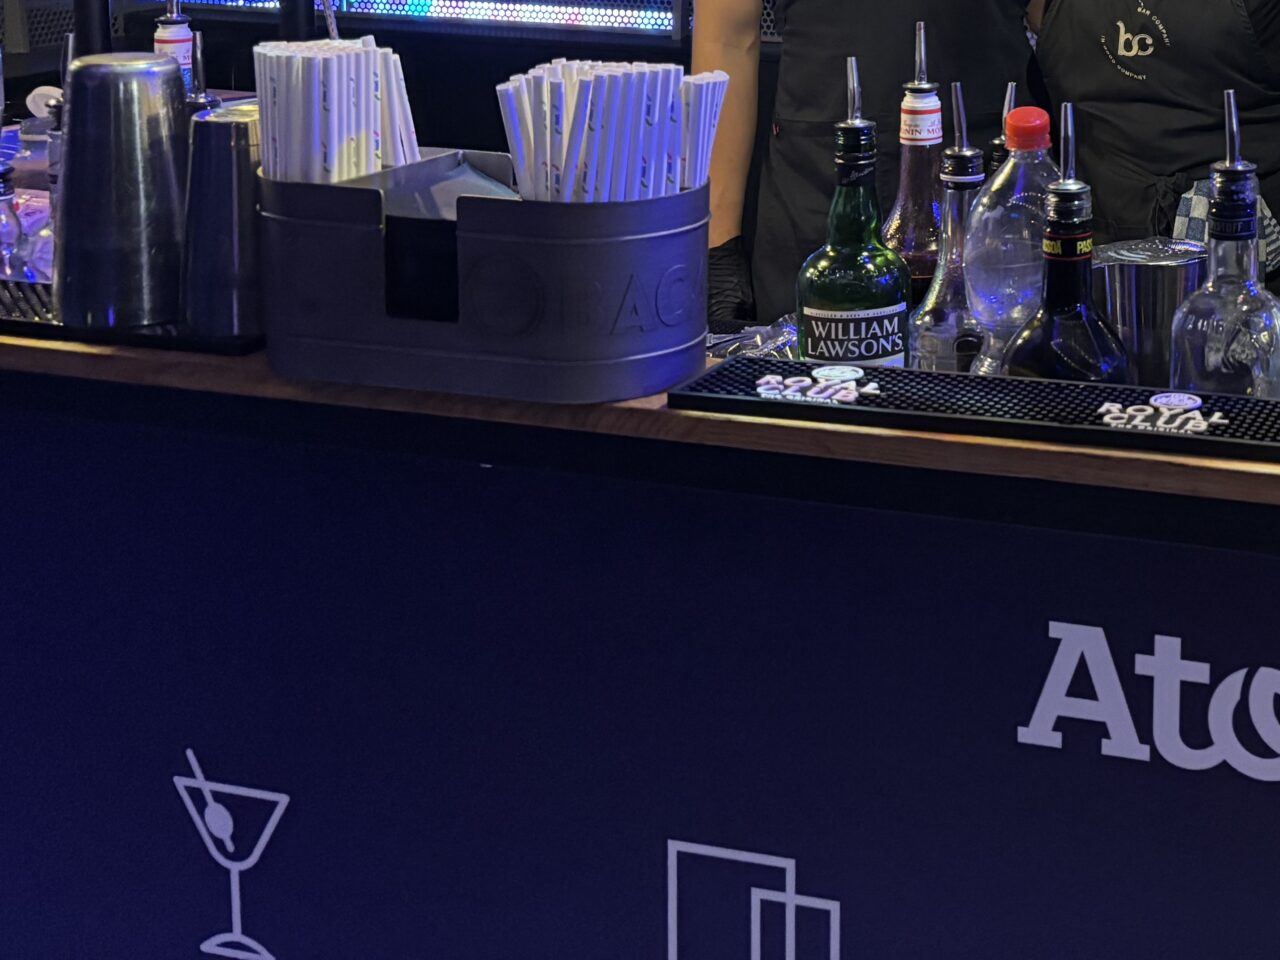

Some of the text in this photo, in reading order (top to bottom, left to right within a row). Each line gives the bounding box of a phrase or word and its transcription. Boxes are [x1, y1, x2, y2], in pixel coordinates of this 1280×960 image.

[812, 316, 898, 339] WILLIAM
[757, 384, 858, 402] CLUB
[1096, 402, 1229, 424] ROYAL
[1103, 412, 1208, 432] CLUB
